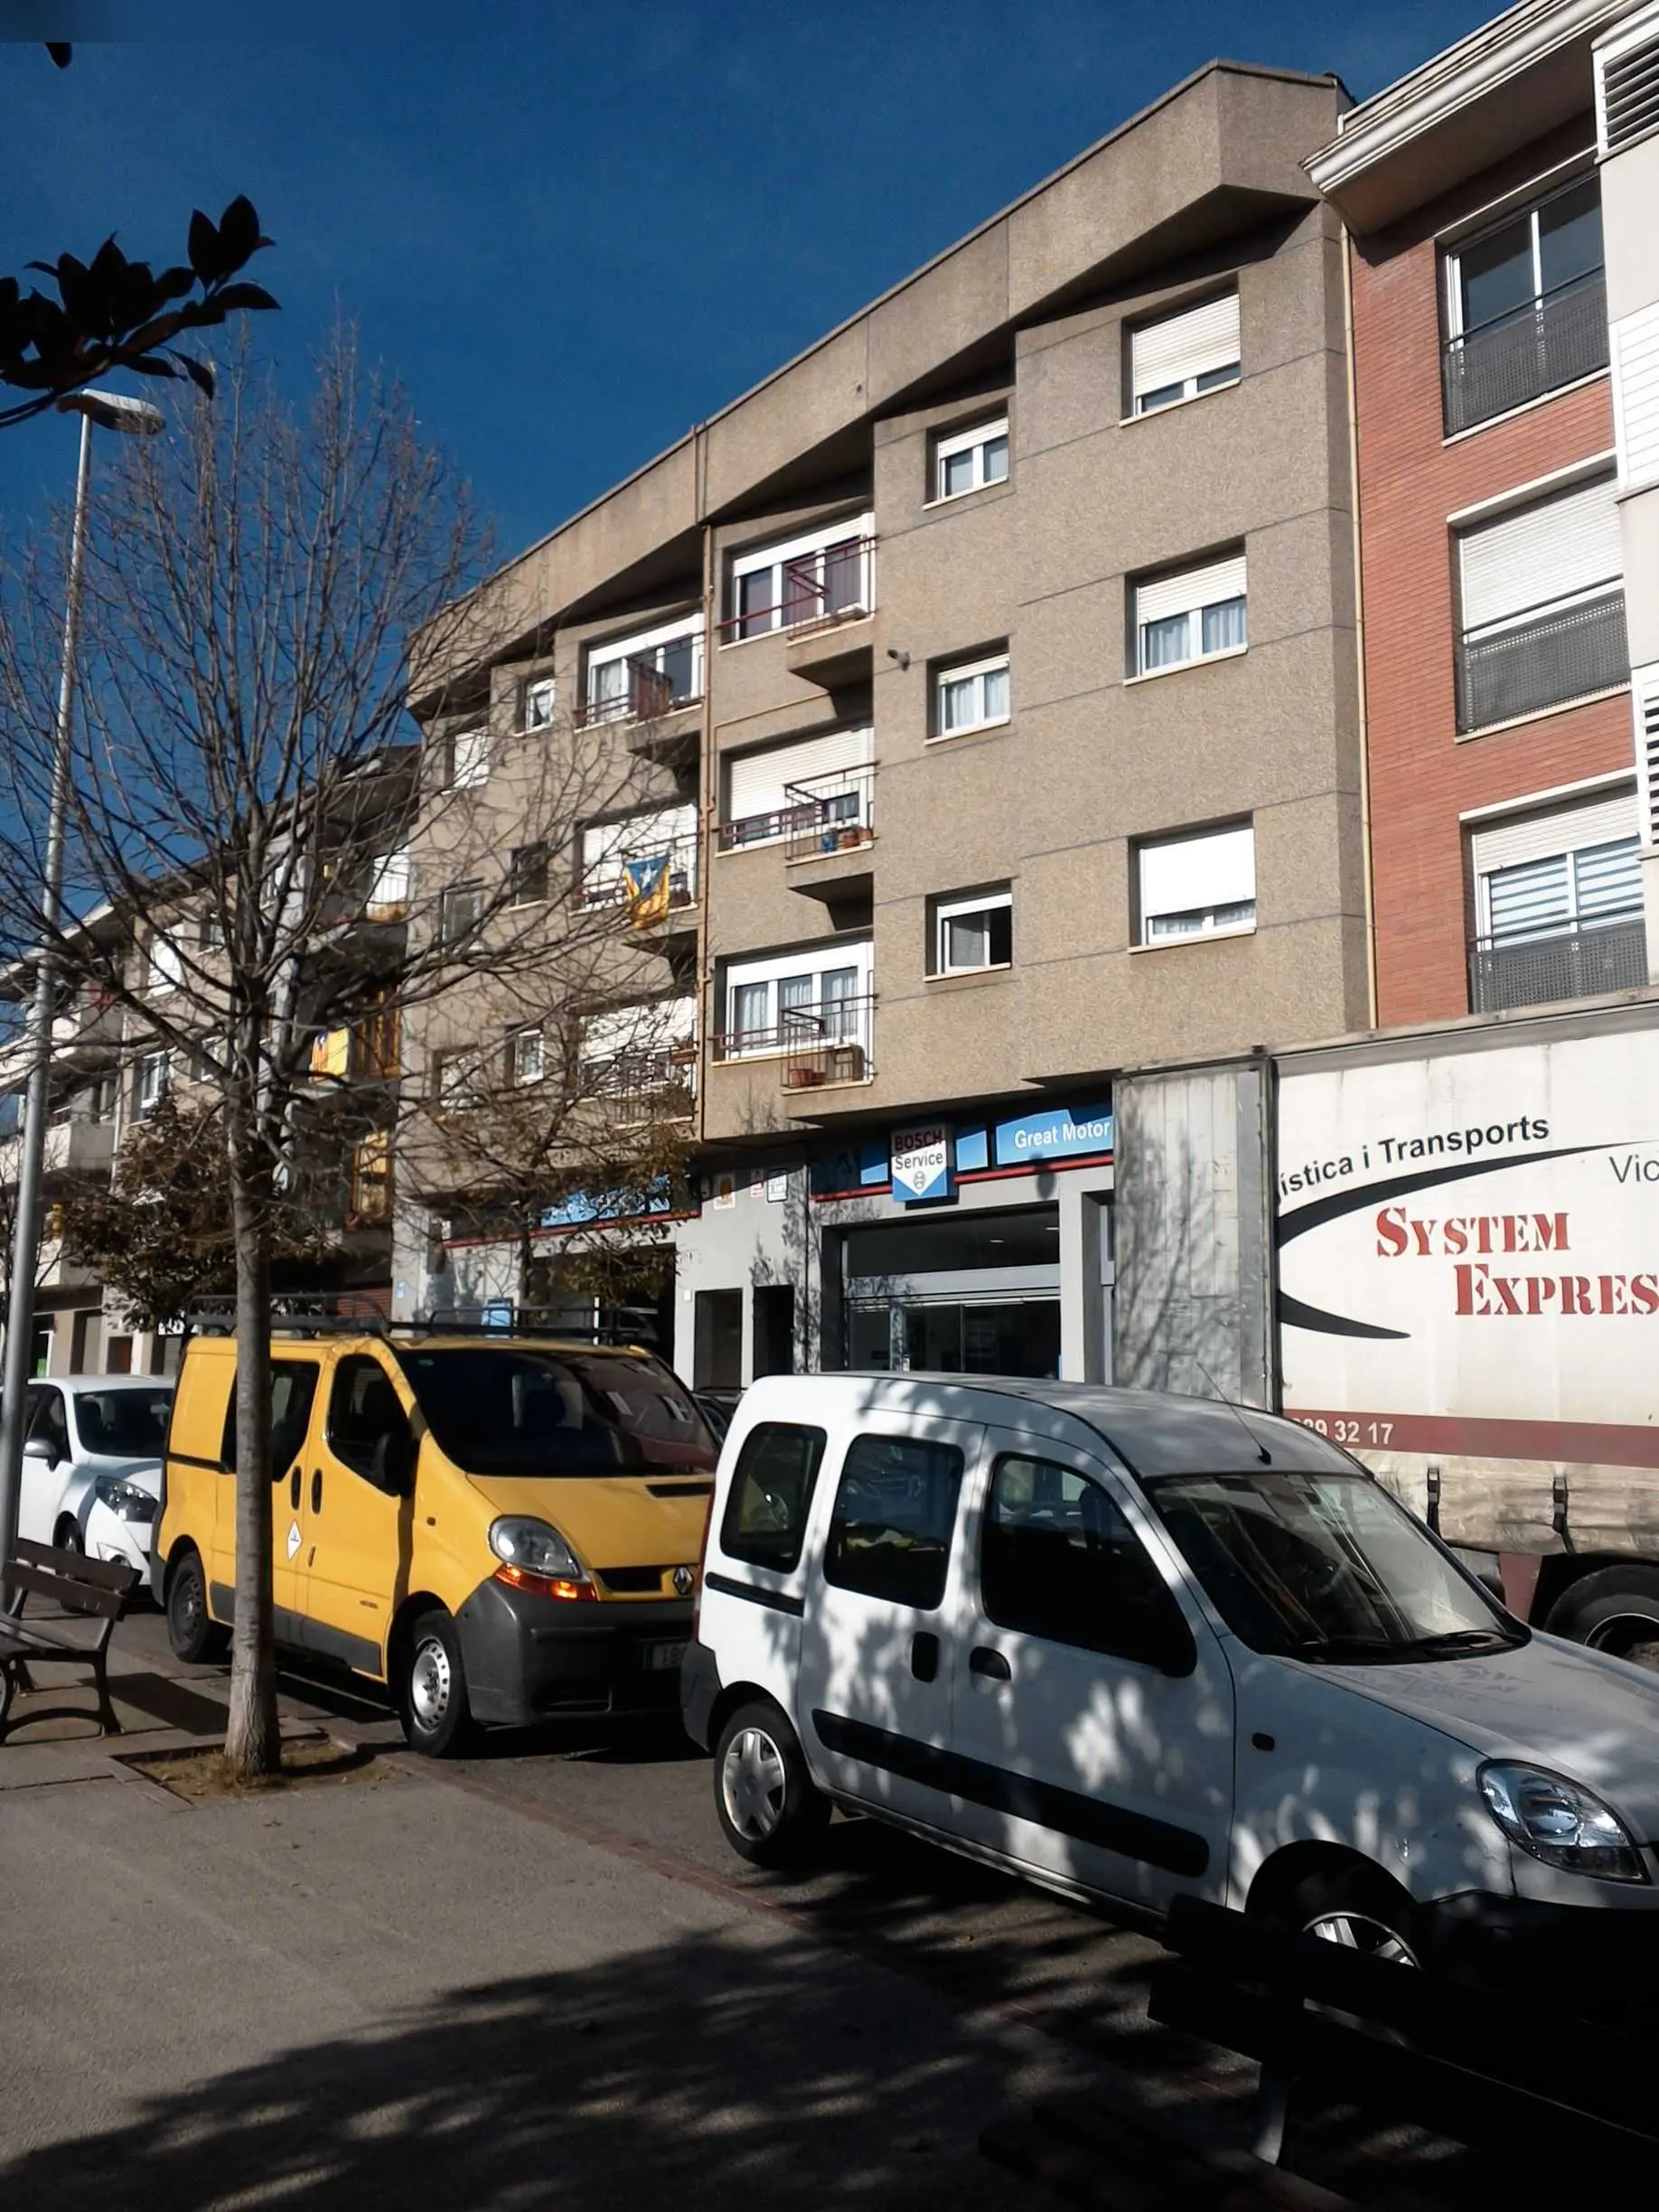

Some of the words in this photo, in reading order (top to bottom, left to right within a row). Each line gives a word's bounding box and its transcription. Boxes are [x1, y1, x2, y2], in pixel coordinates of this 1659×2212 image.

[895, 1129, 942, 1151] BOSCH
[1015, 1126, 1058, 1148] Great
[895, 1151, 943, 1170] Service
[1279, 1157, 1354, 1204] ística
[1363, 1145, 1369, 1168] i
[1379, 1115, 1549, 1164] Transports
[1376, 1207, 1570, 1257] SYSTEM
[1334, 1420, 1360, 1442] 32
[1368, 1422, 1393, 1444] 17
